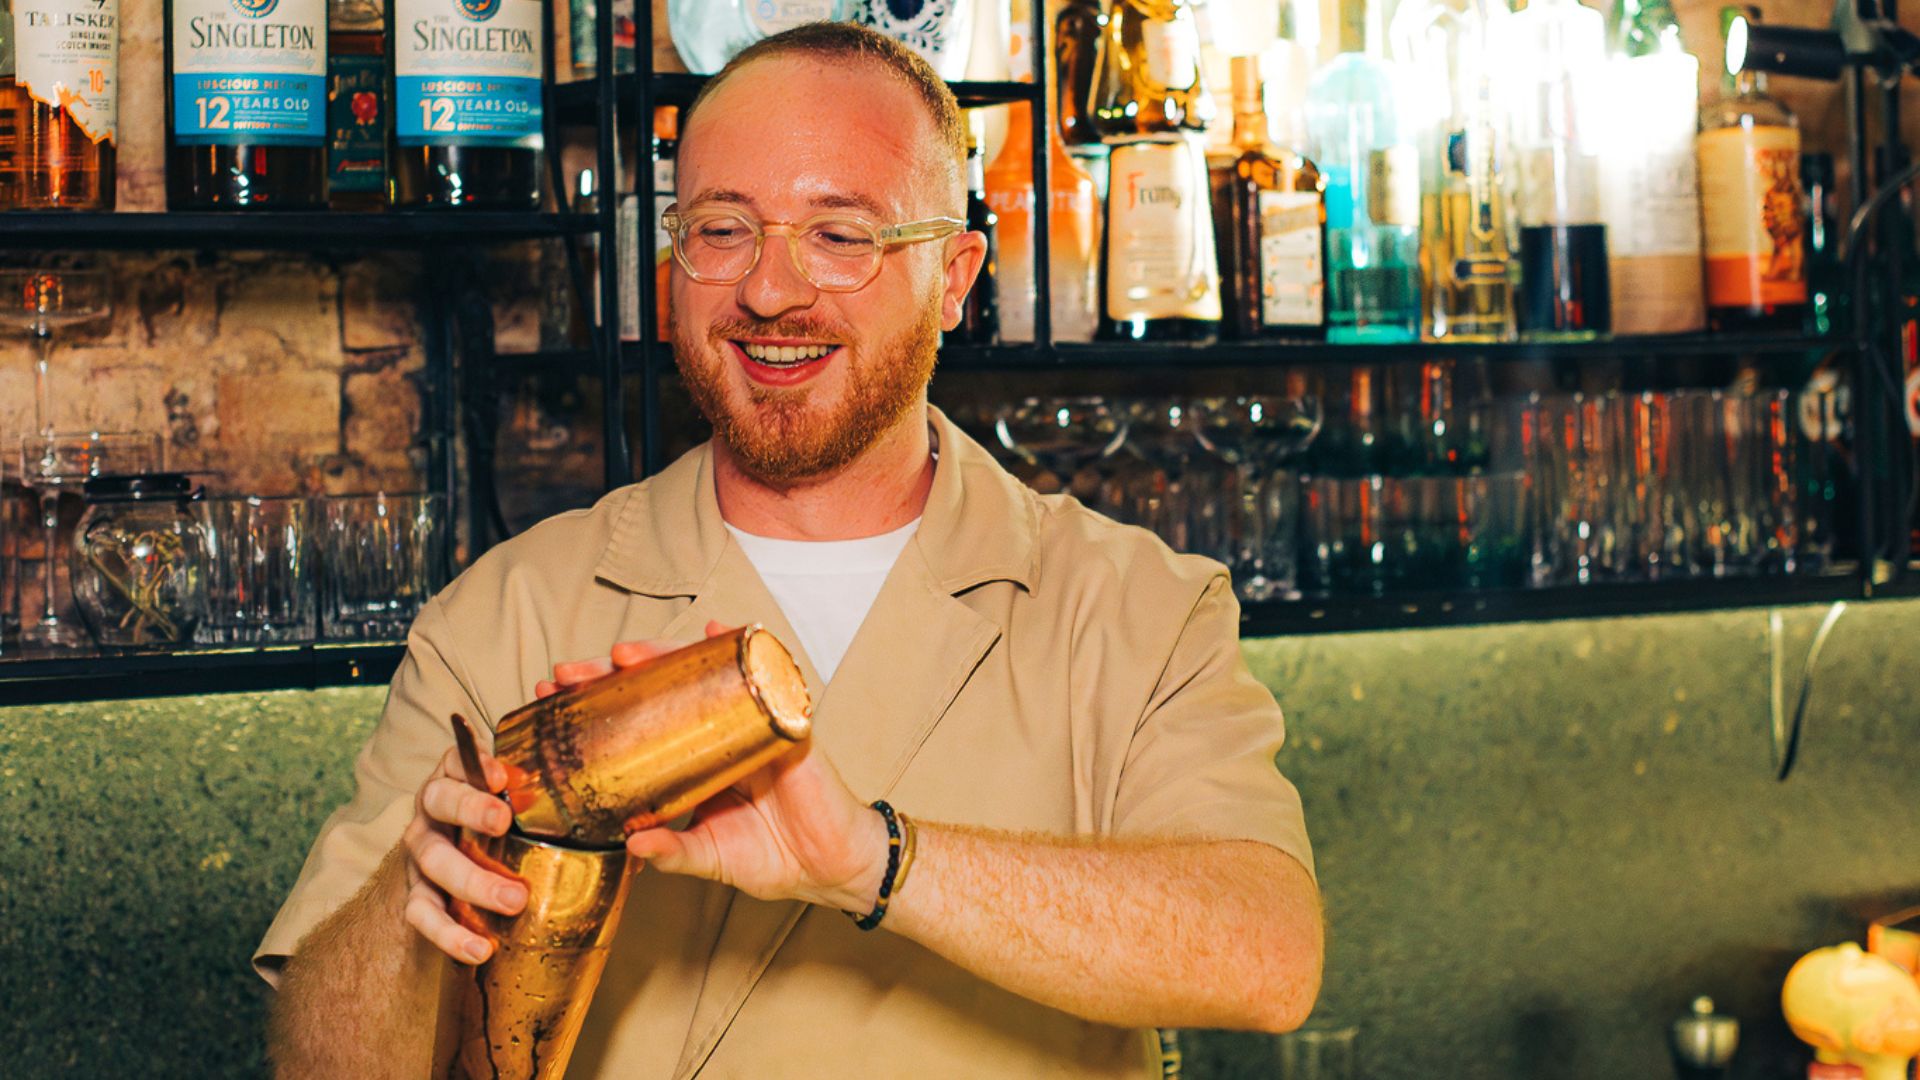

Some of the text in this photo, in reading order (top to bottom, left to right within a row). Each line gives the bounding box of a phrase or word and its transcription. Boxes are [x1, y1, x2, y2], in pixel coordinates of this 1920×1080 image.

[25, 11, 115, 28] TALISKER
[210, 11, 226, 20] THE
[190, 16, 316, 50] SINGLETON
[413, 20, 534, 53] SINGLETON
[89, 68, 104, 96] 10
[197, 79, 260, 90] LUSCIOUS
[421, 80, 482, 93] LUSCIOUS
[232, 96, 310, 111] YEARS OLD
[456, 98, 529, 113] YEARS OLD
[195, 95, 230, 130] 12
[419, 97, 456, 132] 12
